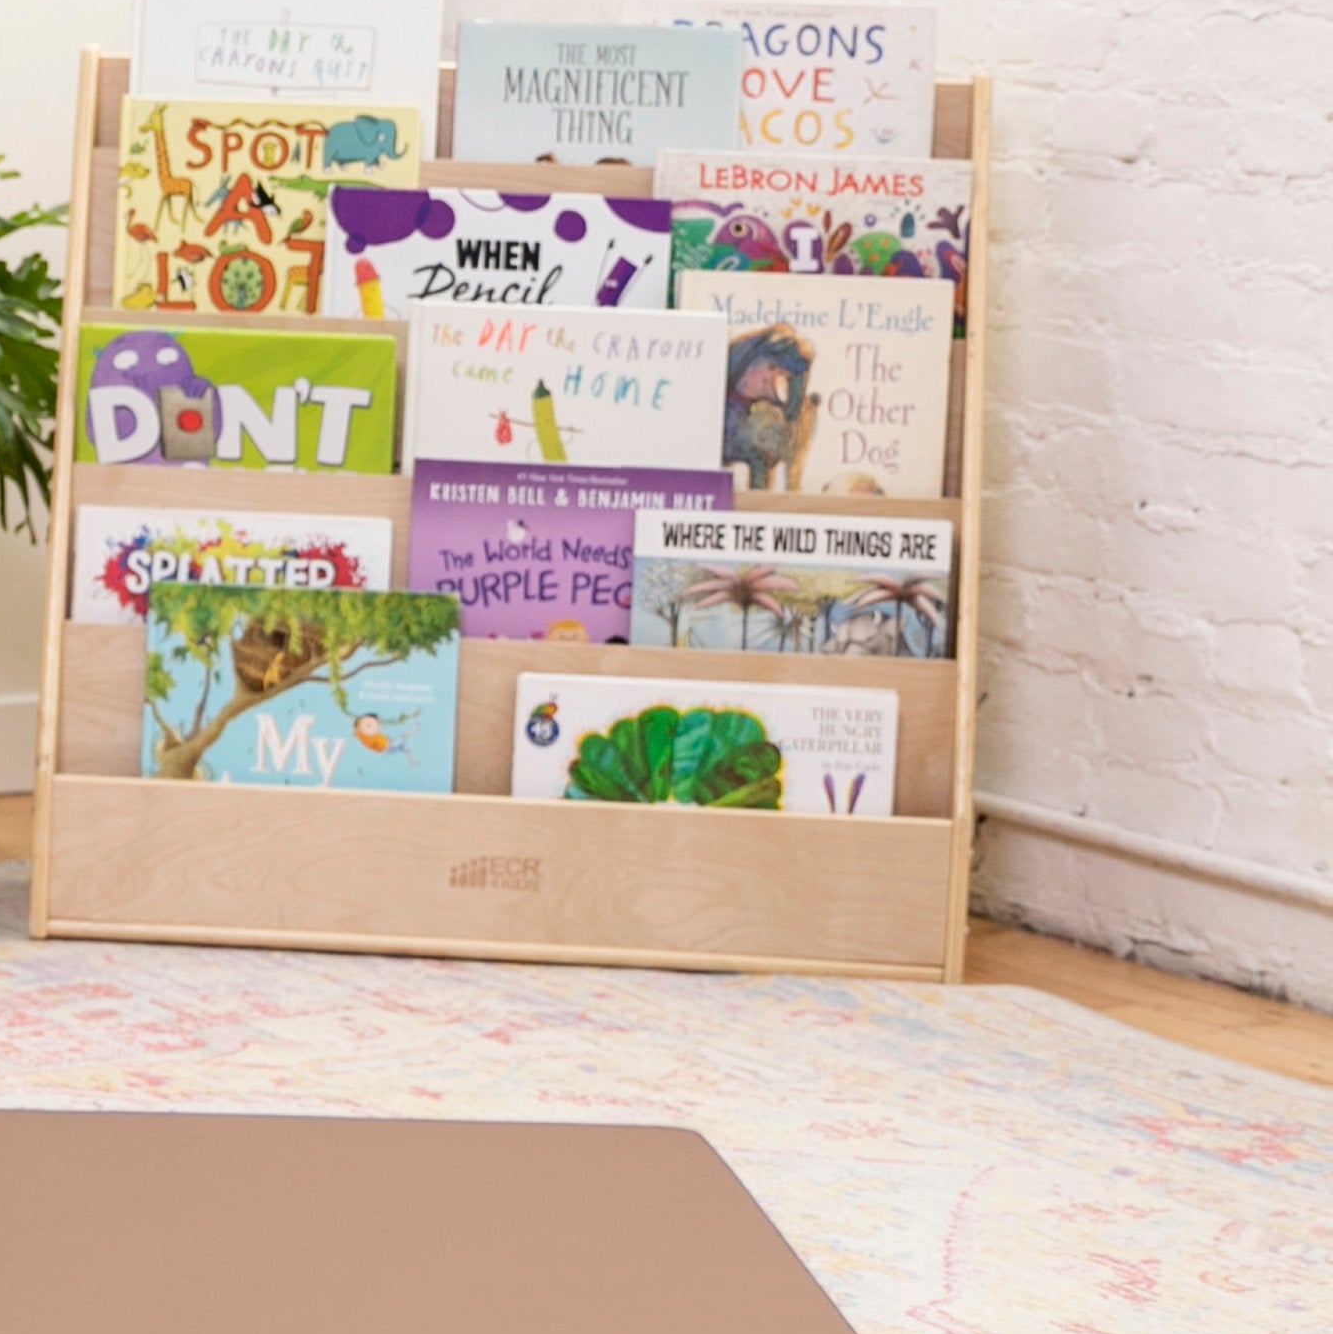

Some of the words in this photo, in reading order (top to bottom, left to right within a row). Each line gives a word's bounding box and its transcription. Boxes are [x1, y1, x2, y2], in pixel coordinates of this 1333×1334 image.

[556, 42, 587, 66] THE
[596, 43, 637, 67] MOST
[674, 19, 886, 64] AGONS
[503, 66, 691, 108] MAGNIFICENT
[740, 67, 834, 103] OVE
[186, 119, 329, 172] SPOT
[551, 107, 634, 145] THING
[827, 166, 925, 197] JAMES
[203, 172, 273, 245] A
[455, 238, 541, 272] WHEN
[837, 298, 936, 336] L'Engle
[477, 318, 538, 353] DAY
[592, 330, 704, 362] CRAYONS
[844, 340, 903, 384] The
[564, 364, 673, 411] HOME
[827, 386, 917, 427] Other
[840, 428, 901, 474] Dog
[429, 481, 500, 505] KRISTEN
[506, 484, 545, 507] BELL
[553, 487, 569, 508] &
[576, 488, 666, 511] BENJAMIN
[672, 492, 715, 512] HART
[439, 549, 474, 571] The
[484, 537, 552, 563] World
[561, 537, 632, 570] Needs
[663, 521, 726, 550] WHERE
[732, 524, 765, 552] THE
[773, 526, 817, 555] WILD
[824, 528, 892, 558] THINGS
[900, 533, 937, 561] ARE
[249, 712, 347, 788] My
